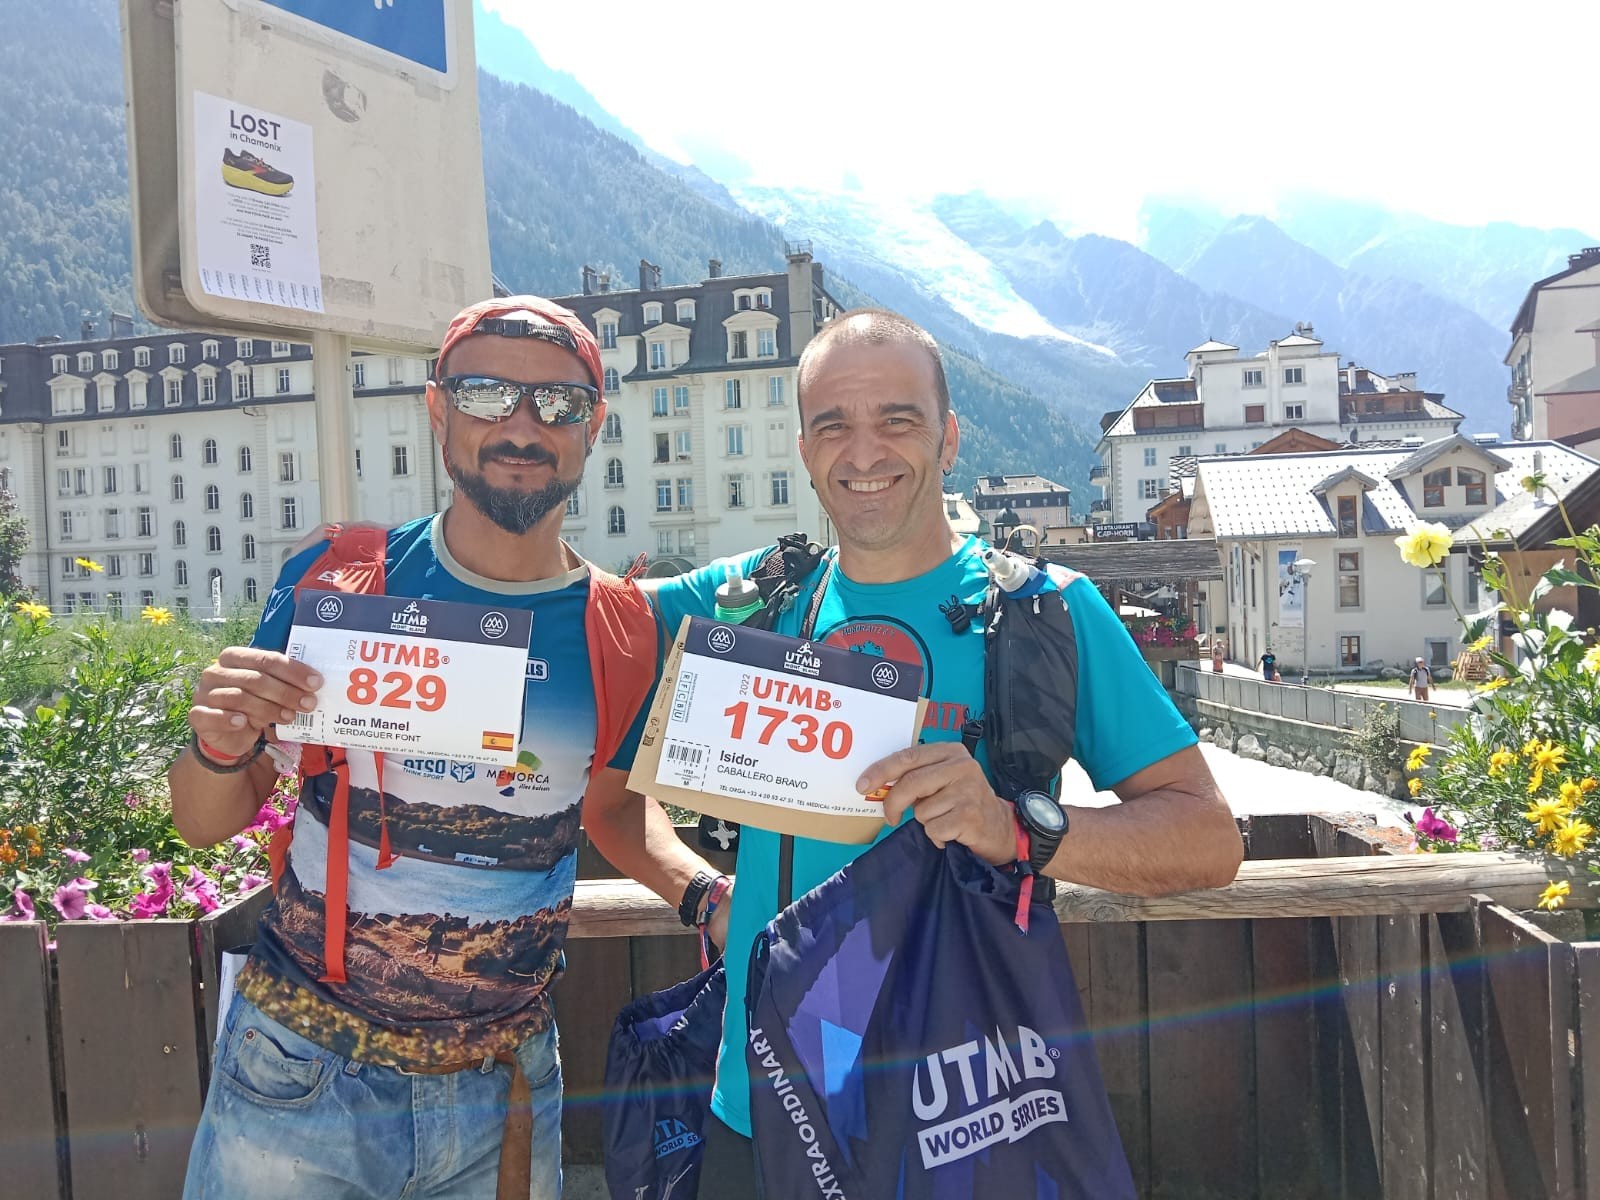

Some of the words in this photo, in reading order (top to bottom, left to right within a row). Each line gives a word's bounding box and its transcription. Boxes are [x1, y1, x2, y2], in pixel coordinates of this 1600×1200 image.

[230, 110, 280, 140] LOST
[230, 131, 237, 140] in
[240, 134, 281, 152] Chamonix
[392, 612, 428, 626] UTMB
[346, 640, 358, 660] 2022
[785, 651, 822, 668] UTMB
[347, 668, 446, 712] 829
[740, 673, 750, 696] 2022
[334, 714, 366, 726] Joan
[370, 718, 409, 731] Manel
[724, 701, 853, 759] 1730
[334, 727, 393, 739] VERDAGUER
[395, 734, 421, 742] FONT
[720, 750, 758, 767] Isidor
[402, 767, 422, 777] THINK
[423, 772, 445, 781] SPORT
[486, 769, 549, 783] MENORCA
[717, 764, 773, 783] CABALLERO
[776, 777, 808, 789] BRAVO
[925, 1112, 1004, 1158] WORLD
[1012, 1096, 1060, 1131] SERIES
